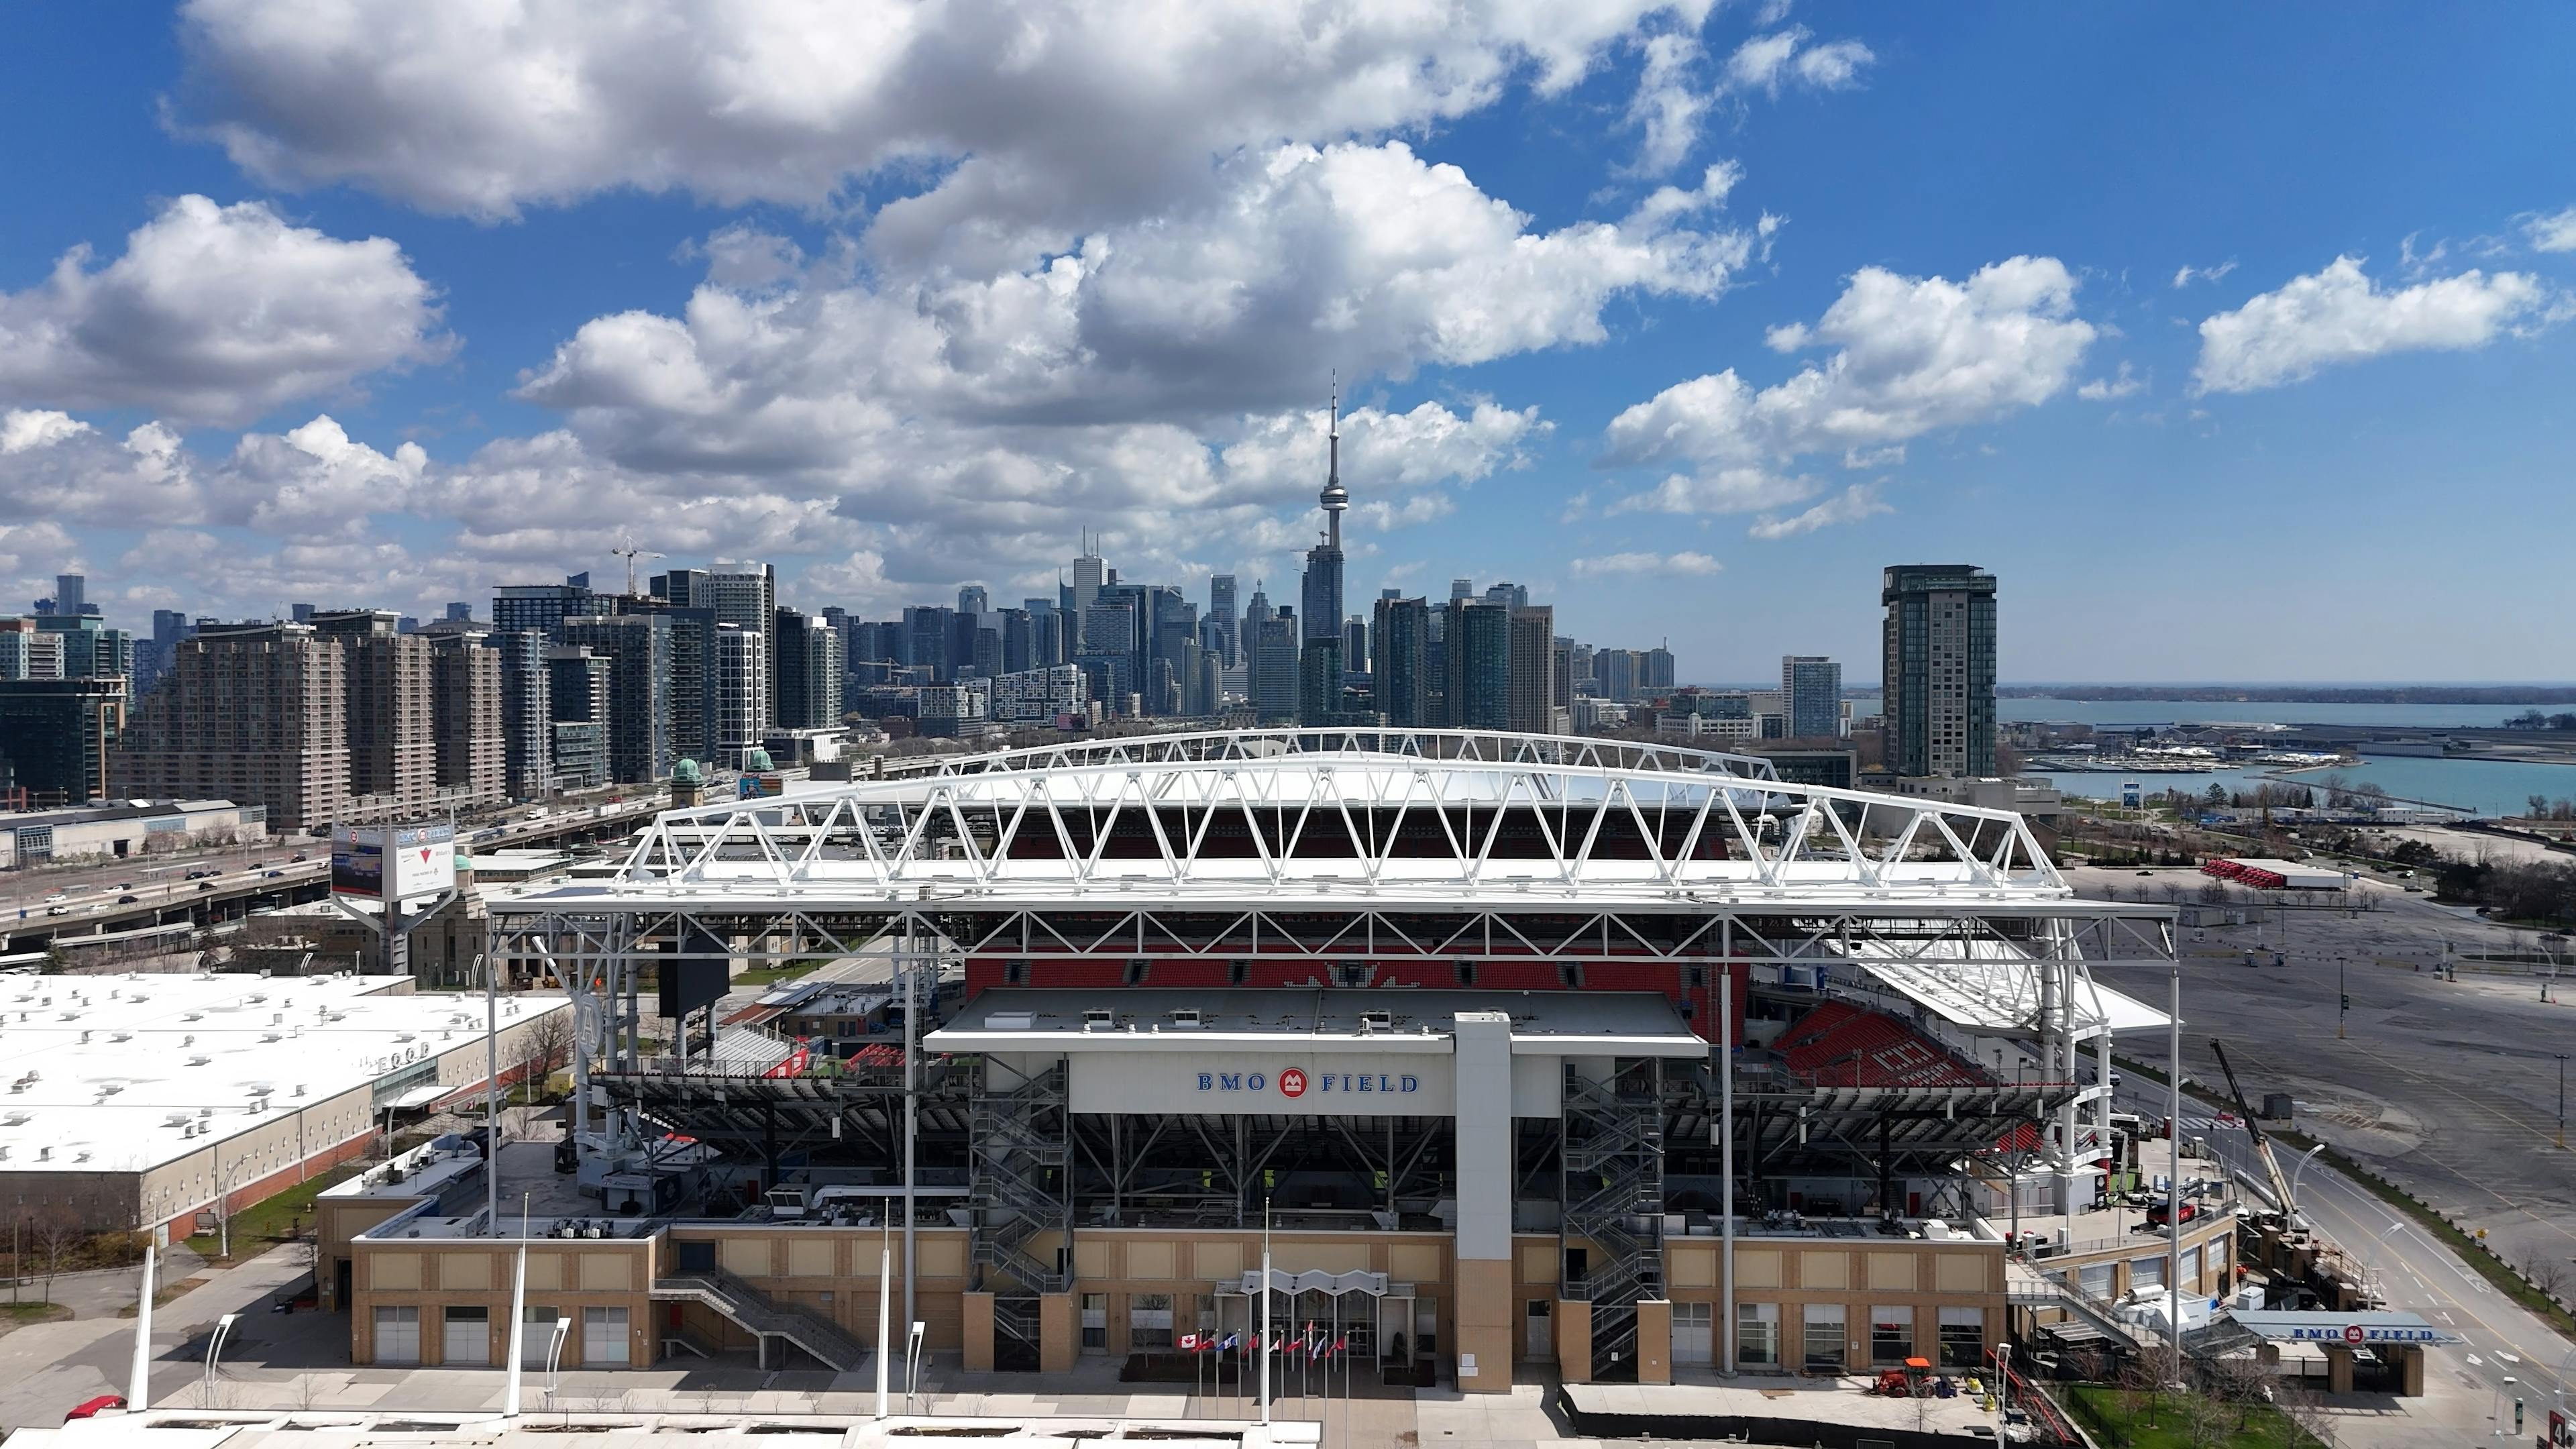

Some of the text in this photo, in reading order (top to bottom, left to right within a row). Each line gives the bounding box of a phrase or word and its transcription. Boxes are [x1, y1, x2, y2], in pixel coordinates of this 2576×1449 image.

[580, 1003, 597, 1047] A
[1197, 1073, 1419, 1093] BMO FIELD
[2293, 1328, 2433, 1340] BMO FIELD
[2555, 1423, 2563, 1444] 4
